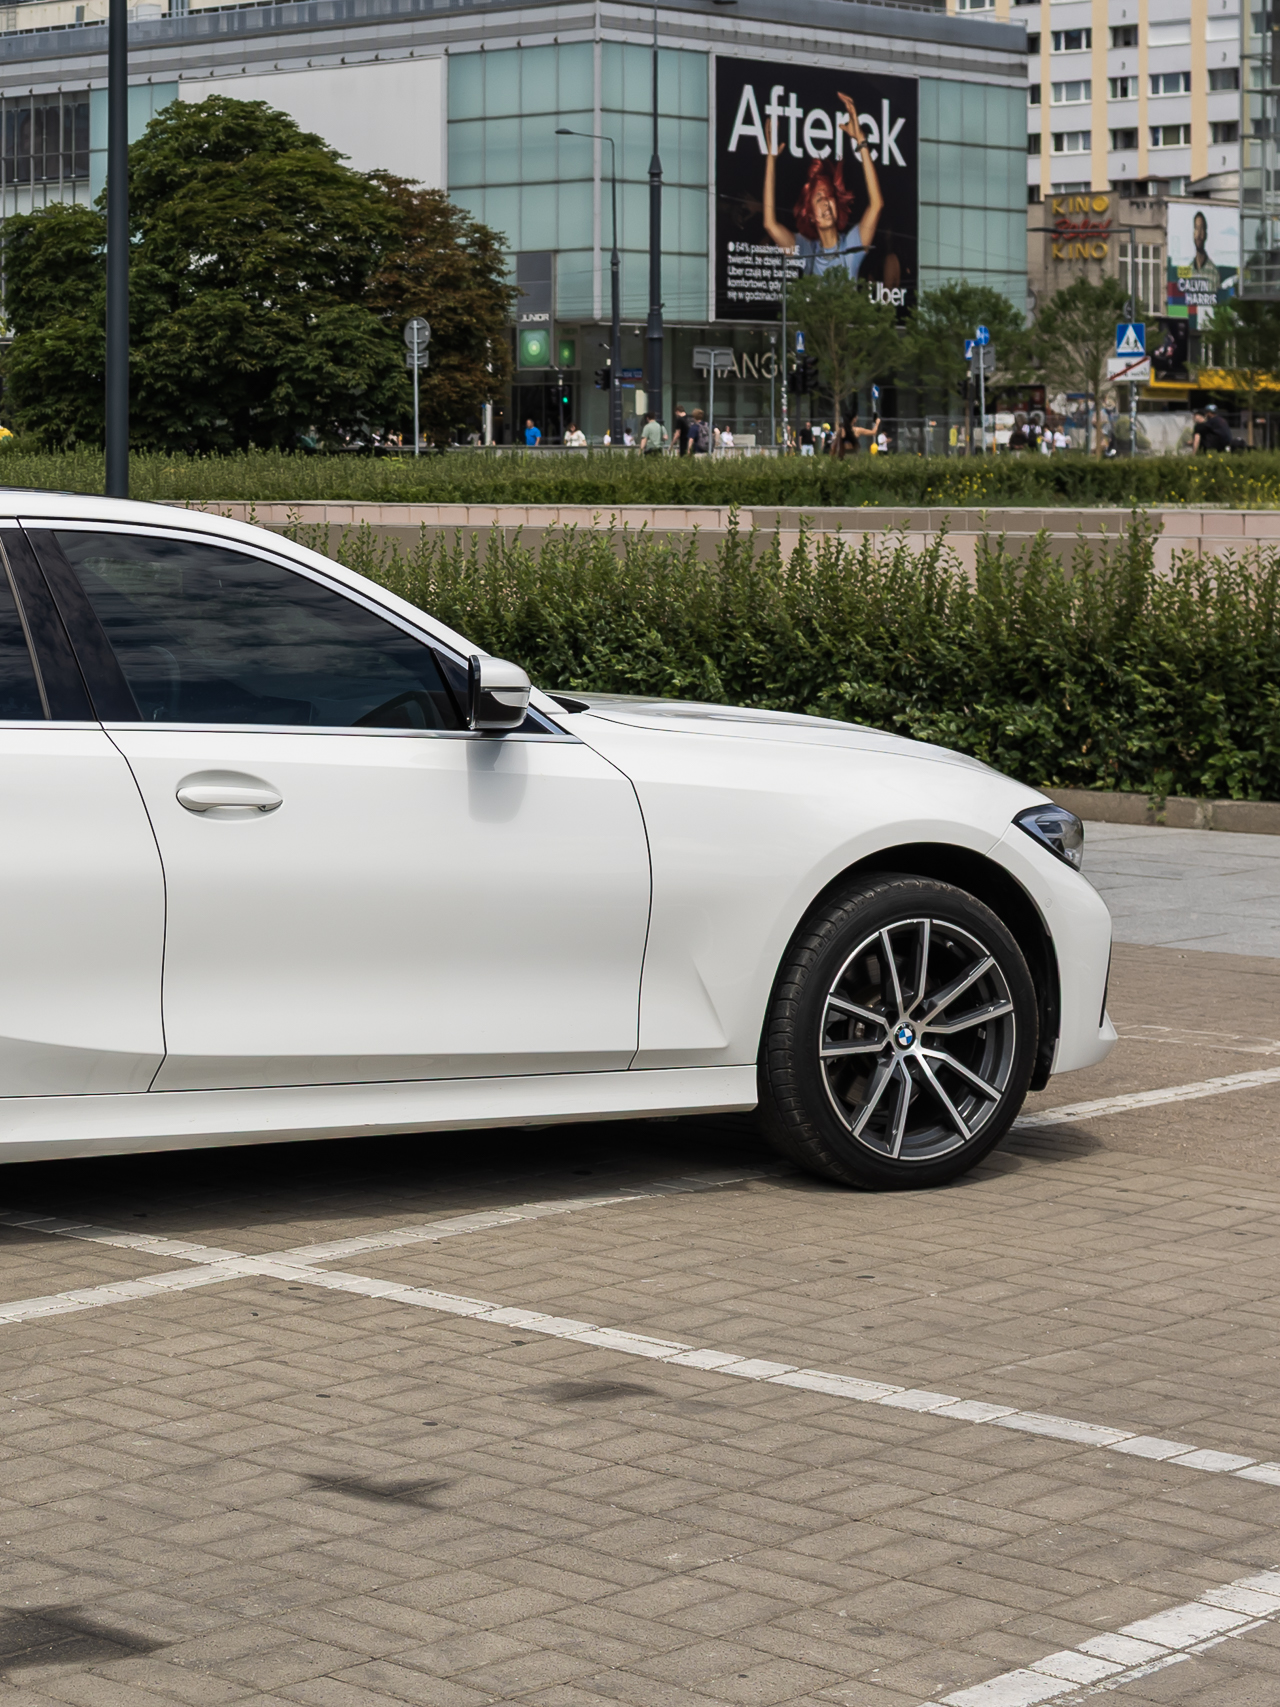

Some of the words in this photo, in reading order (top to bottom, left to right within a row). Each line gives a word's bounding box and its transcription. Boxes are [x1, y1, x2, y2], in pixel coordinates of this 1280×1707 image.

[728, 84, 907, 167] Afterek
[1052, 195, 1109, 215] KINO
[1052, 242, 1108, 261] KINO
